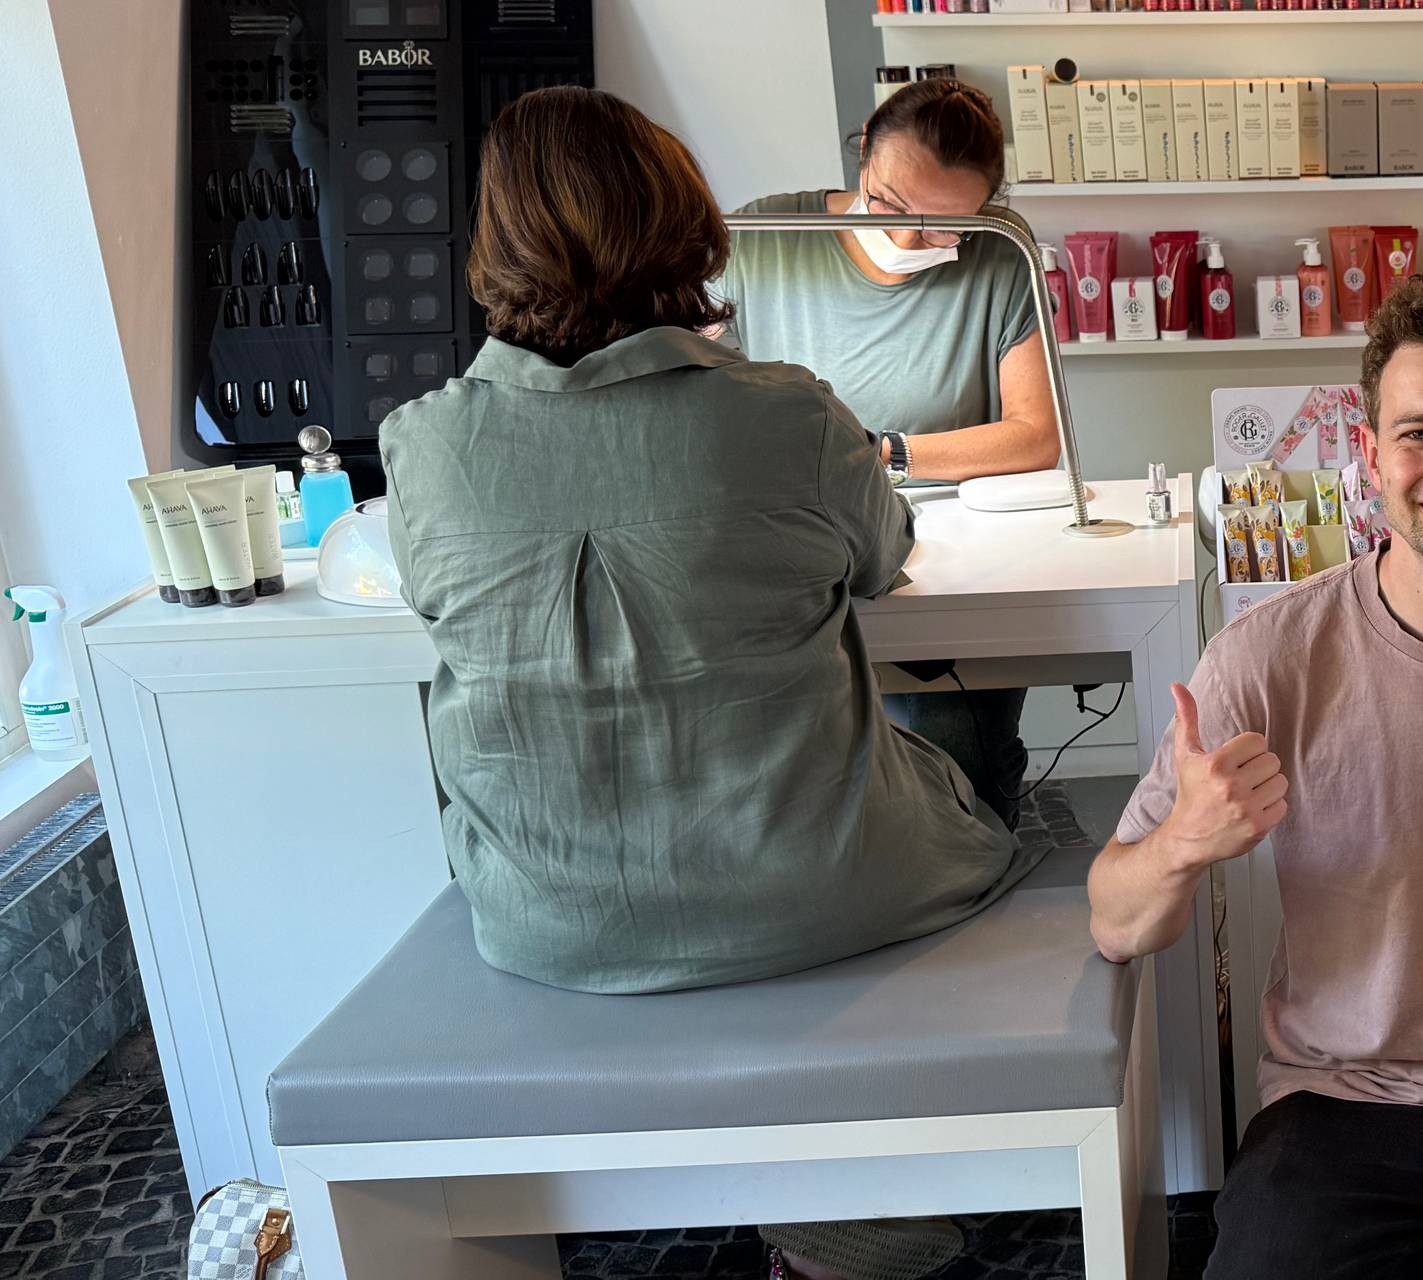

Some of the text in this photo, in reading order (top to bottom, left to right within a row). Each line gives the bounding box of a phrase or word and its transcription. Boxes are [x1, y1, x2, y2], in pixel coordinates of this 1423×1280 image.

[358, 44, 433, 68] BABOR
[161, 504, 188, 515] AHAVA
[201, 504, 227, 515] AHAVA
